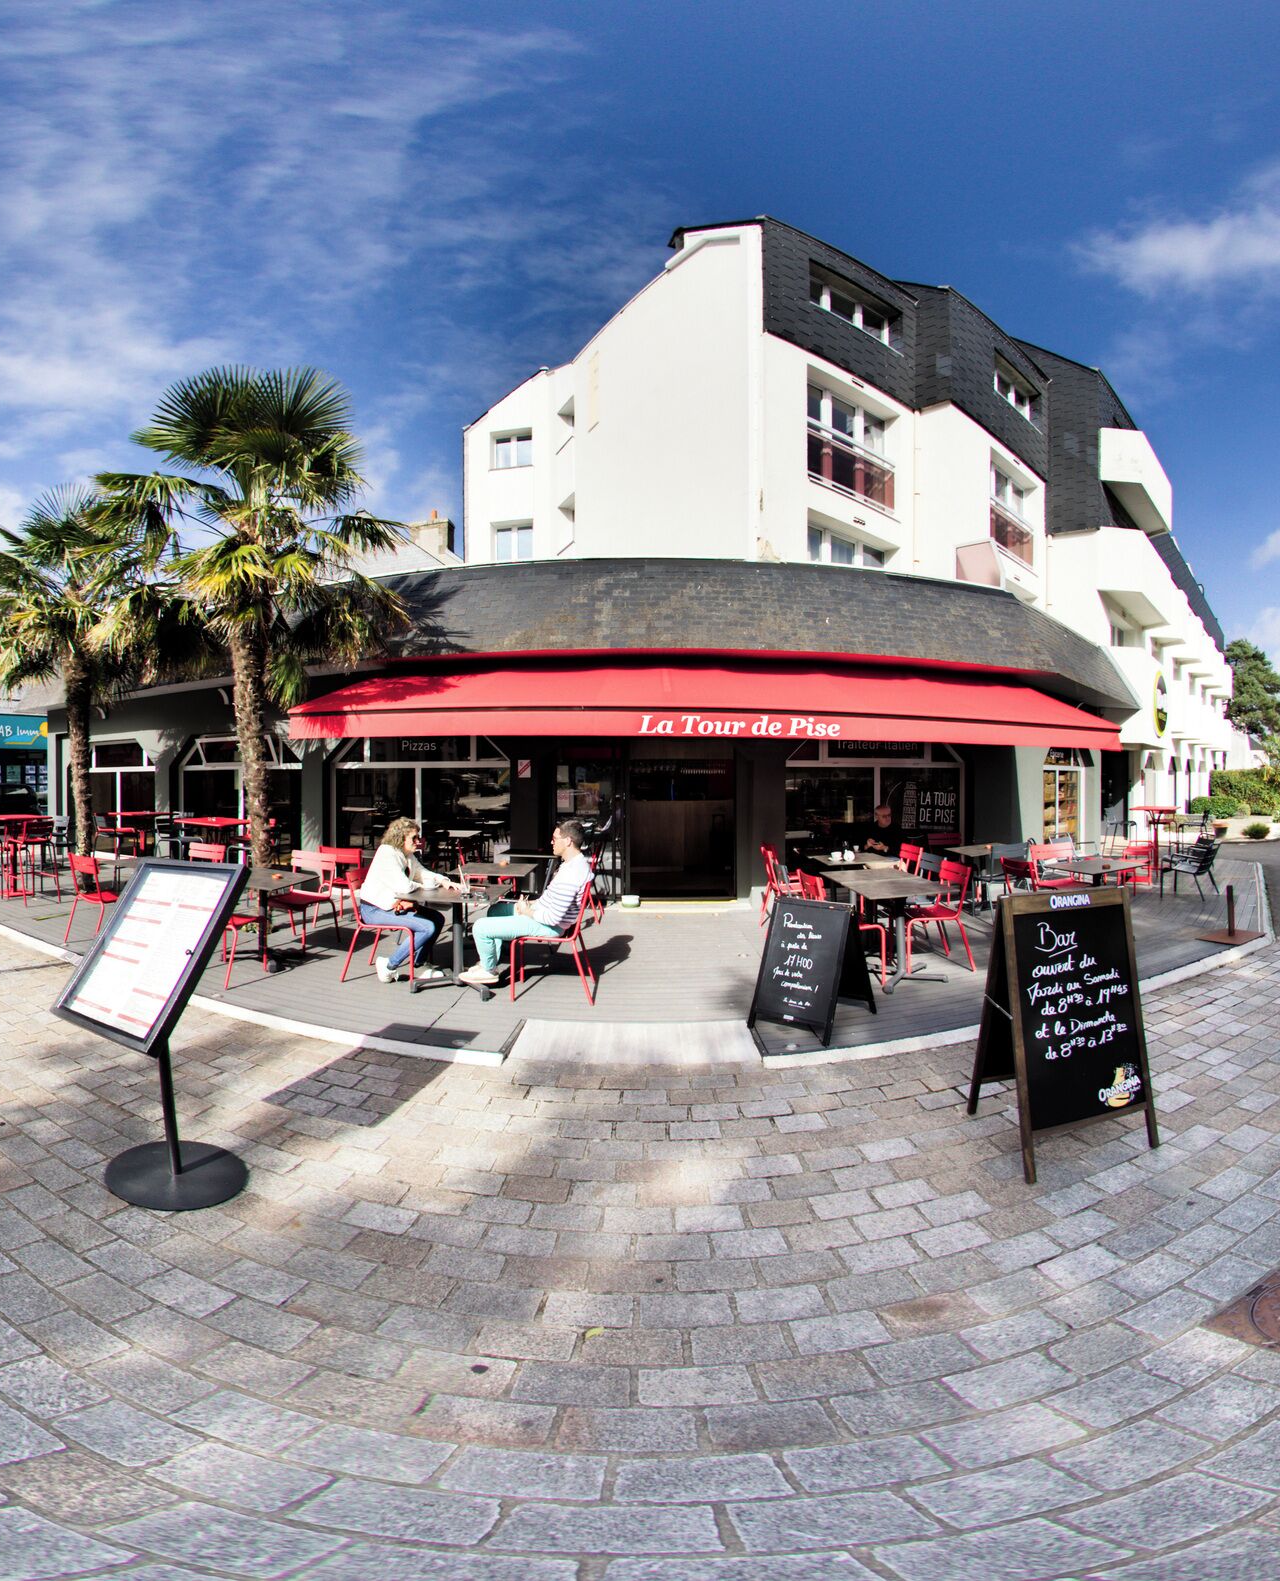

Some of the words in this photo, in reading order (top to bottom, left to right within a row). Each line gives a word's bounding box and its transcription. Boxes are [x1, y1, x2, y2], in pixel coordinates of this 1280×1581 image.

[638, 715, 674, 734] La
[681, 715, 745, 735] Tour
[751, 716, 782, 736] de
[787, 717, 841, 737] Pise
[402, 740, 437, 751] Pizzas
[837, 740, 880, 750] Traiteur
[920, 791, 932, 806] LA
[934, 791, 956, 807] TOUR
[920, 808, 932, 822] DE
[935, 808, 955, 824] PISE
[1050, 895, 1090, 909] ORANGINA
[1035, 921, 1078, 952] Bar
[1032, 954, 1075, 978] ouvert
[1079, 953, 1097, 968] du
[1027, 981, 1063, 1006] Mardi
[1067, 980, 1082, 992] au
[1083, 968, 1120, 986] Samedi
[1041, 1001, 1057, 1016] de
[1057, 993, 1084, 1013] 8H30
[1085, 996, 1093, 1007] à
[1096, 984, 1128, 1005] 19H45
[1035, 1023, 1050, 1039] et
[1054, 1021, 1067, 1036] le
[1070, 1010, 1116, 1035] Dimanche
[1045, 1046, 1059, 1060] de
[1088, 1036, 1097, 1048] à
[1098, 1075, 1141, 1102] ORANGINA
